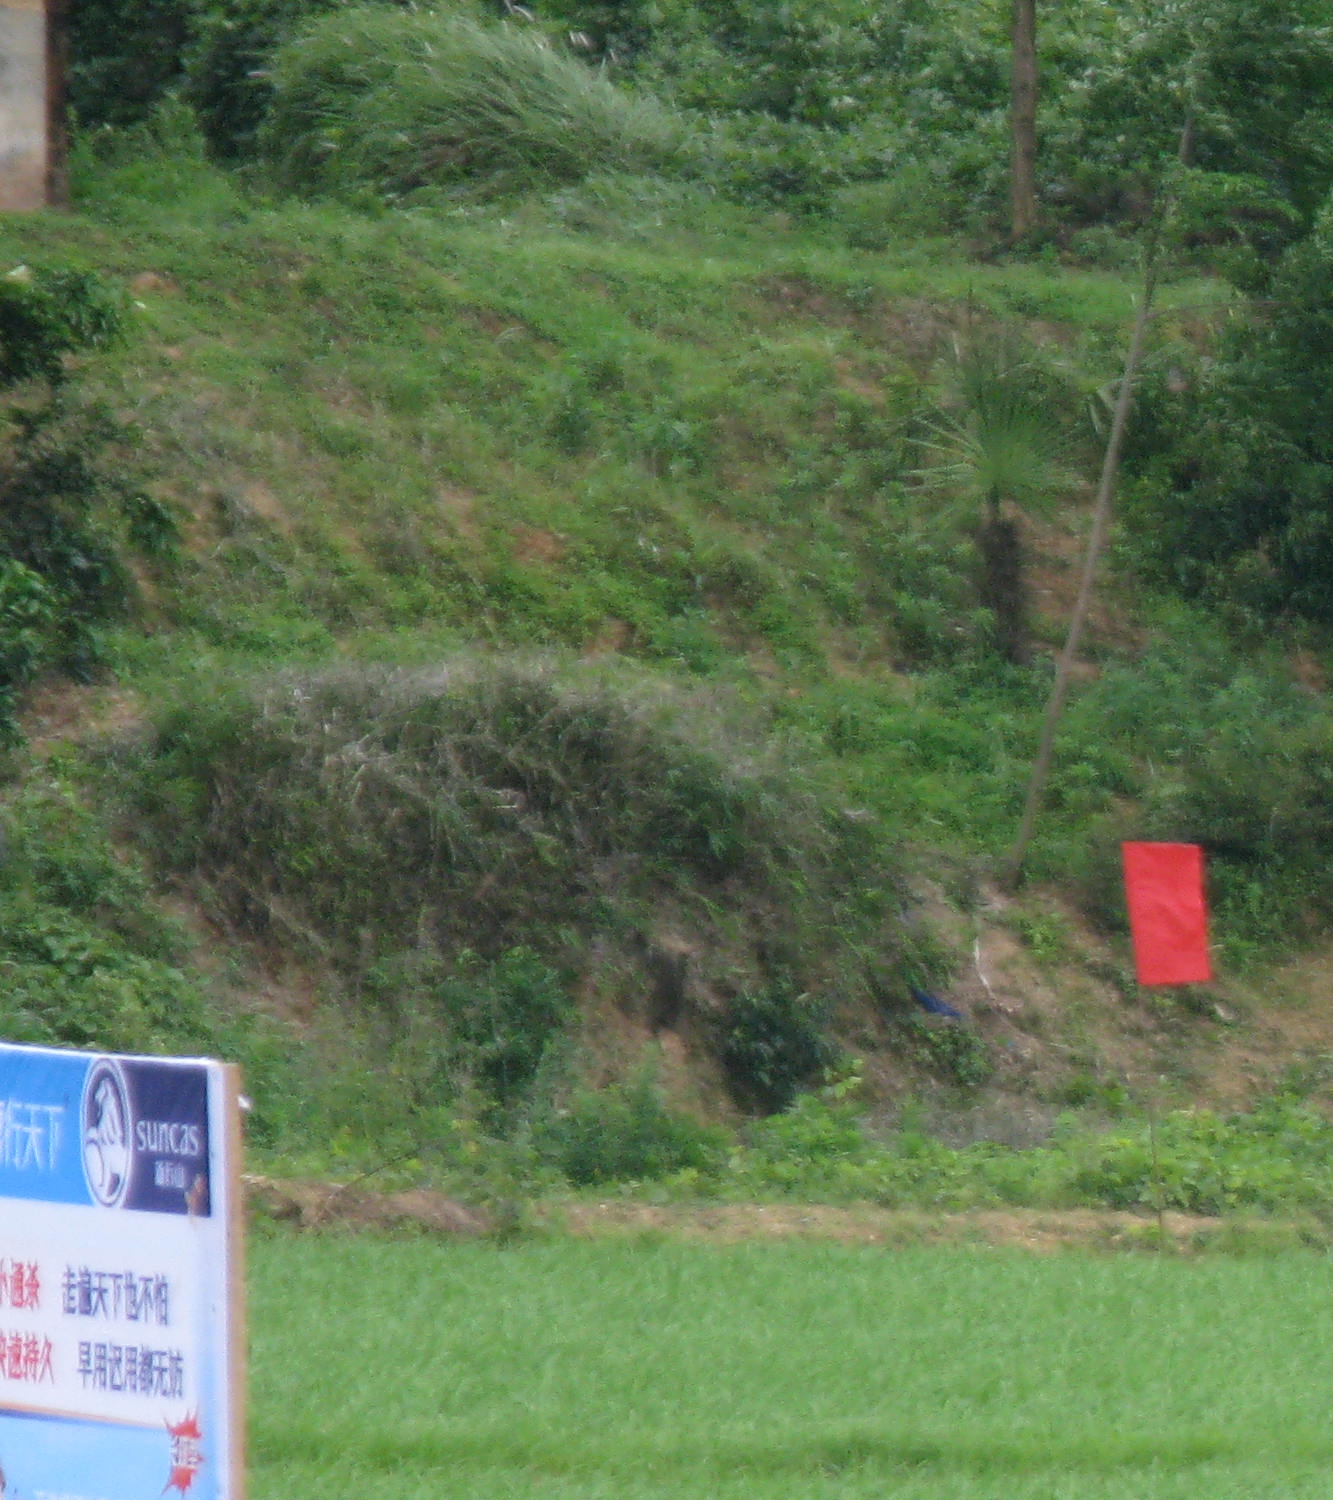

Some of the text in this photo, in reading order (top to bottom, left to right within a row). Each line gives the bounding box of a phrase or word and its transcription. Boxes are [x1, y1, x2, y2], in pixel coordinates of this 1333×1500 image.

[0, 1098, 64, 1170] 行天下
[135, 1120, 199, 1156] suncas
[62, 1265, 168, 1326] 走遍天下也不怕
[78, 1340, 183, 1398] 早用迟用都无妨
